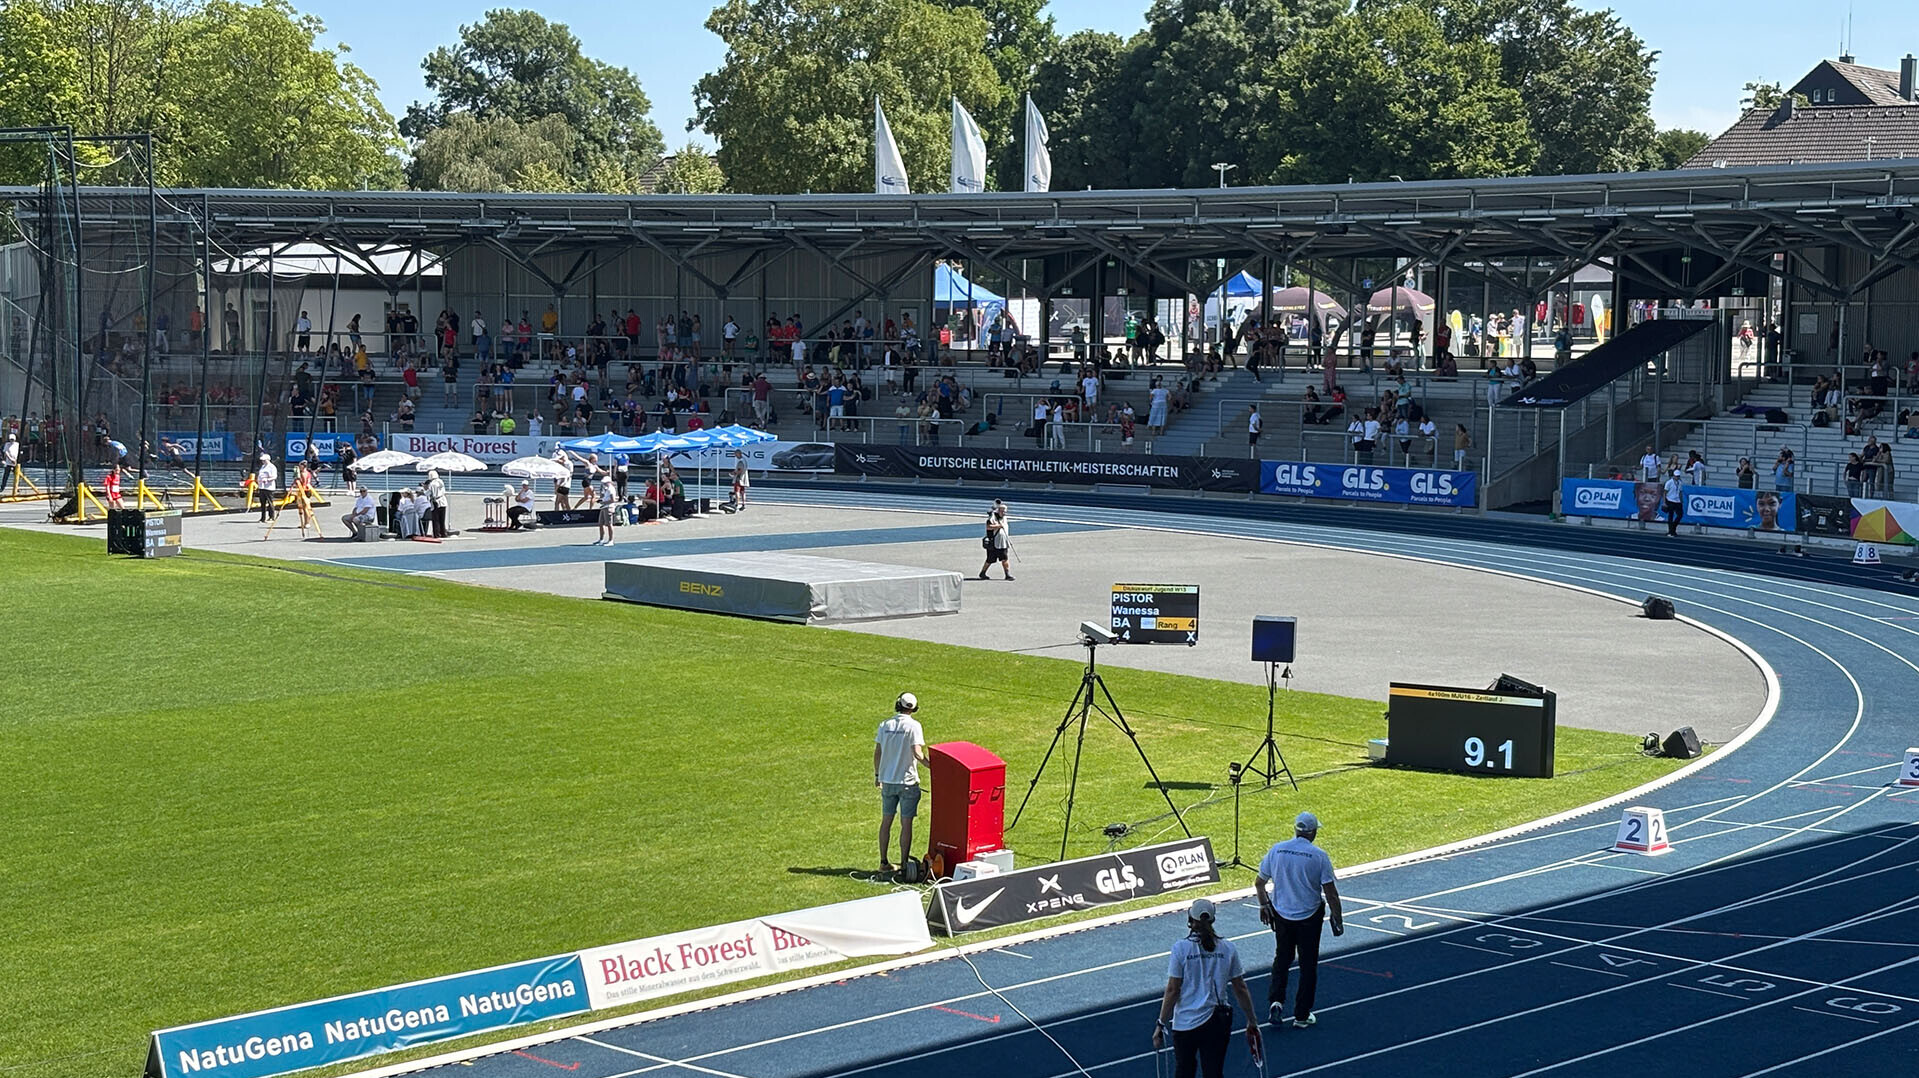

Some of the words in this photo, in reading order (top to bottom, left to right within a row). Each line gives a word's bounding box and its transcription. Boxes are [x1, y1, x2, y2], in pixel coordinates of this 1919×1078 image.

[409, 437, 458, 454] Black
[463, 438, 518, 454] Forest
[697, 449, 765, 459] XPENG
[919, 456, 977, 469] DEUTSCHE
[980, 458, 1178, 478] LEICHTATHLETIK-MEISTERSCHAFTEN
[1593, 491, 1619, 502] PLAN
[1708, 500, 1732, 510] PLAN
[1857, 547, 1864, 558] 8
[1868, 547, 1875, 558] 8
[680, 581, 721, 597] BENZ
[1112, 593, 1154, 603] PISTOR
[1112, 605, 1160, 616] Wanessa
[1112, 617, 1131, 628] BA
[1158, 622, 1178, 630] Rang
[1188, 620, 1195, 628] 4
[1122, 630, 1131, 640] 4
[1186, 631, 1196, 641] X
[1464, 736, 1513, 770] 9.1
[1909, 758, 1919, 778] 3
[1625, 818, 1642, 842] 2
[1652, 819, 1662, 842] 2
[1177, 852, 1204, 867] PLAN
[1026, 893, 1085, 914] XPENG
[1370, 914, 1440, 931] 2
[1475, 933, 1543, 949] 3
[599, 947, 675, 985] Black
[676, 933, 757, 970] Forest
[1599, 953, 1658, 967] 4
[606, 989, 620, 1000] Das
[620, 986, 638, 997] stille
[639, 977, 687, 993] Mineralwasser
[689, 974, 700, 983] aus
[701, 971, 716, 981] dem
[1697, 974, 1776, 992] 5
[1825, 997, 1902, 1014] 6
[179, 1031, 314, 1074] NatuGena
[324, 1004, 450, 1045] NatuGena
[459, 979, 576, 1018] NatuGena
